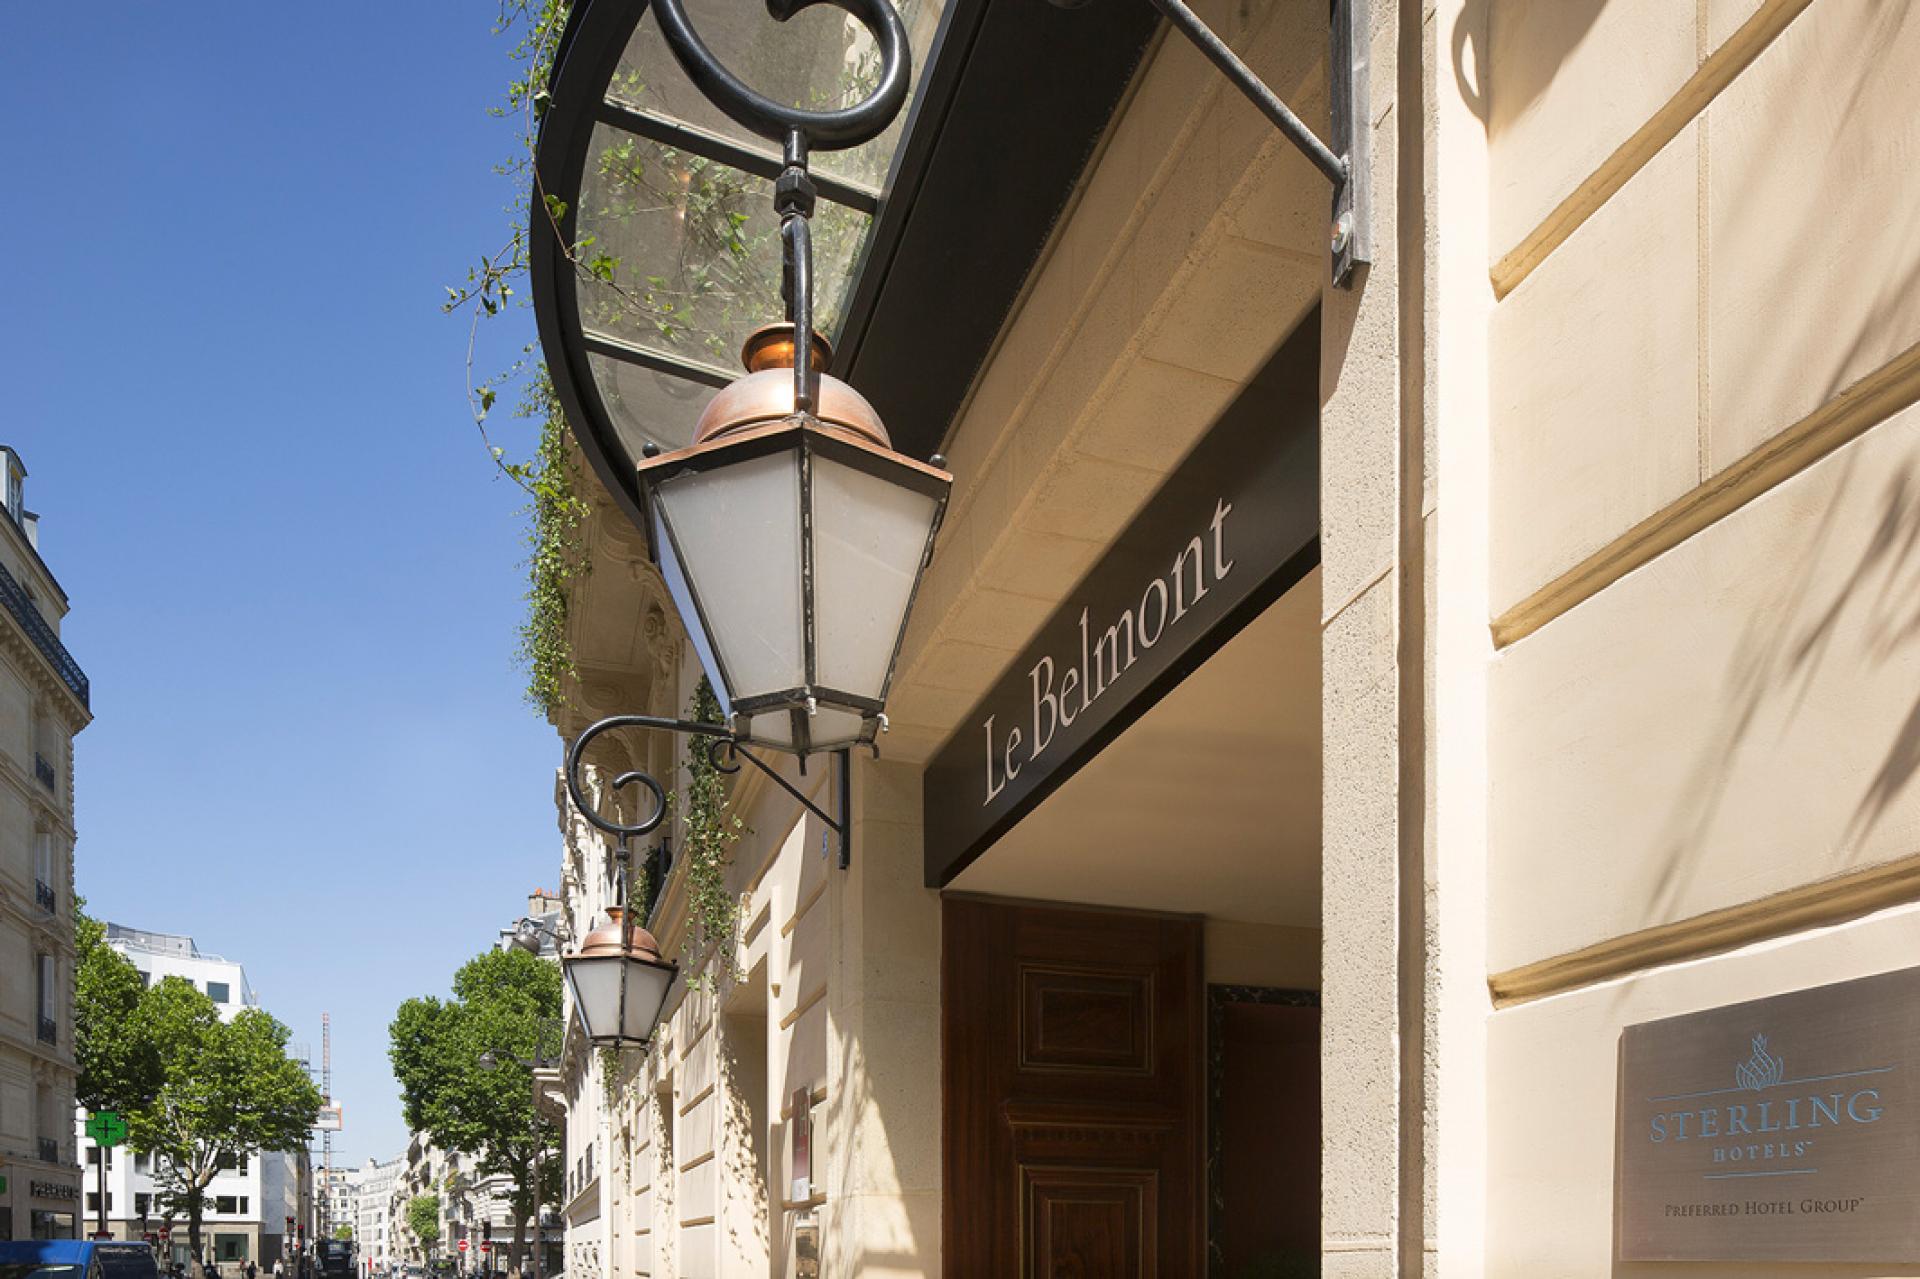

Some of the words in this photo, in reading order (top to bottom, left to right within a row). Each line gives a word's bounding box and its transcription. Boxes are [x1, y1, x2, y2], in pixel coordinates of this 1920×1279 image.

[982, 713, 1022, 806] Le
[1028, 497, 1234, 762] Belmont
[1650, 1089, 1883, 1143] STERLING
[1664, 1203, 1739, 1217] PREFERRED
[1745, 1201, 1795, 1216] HOTEL
